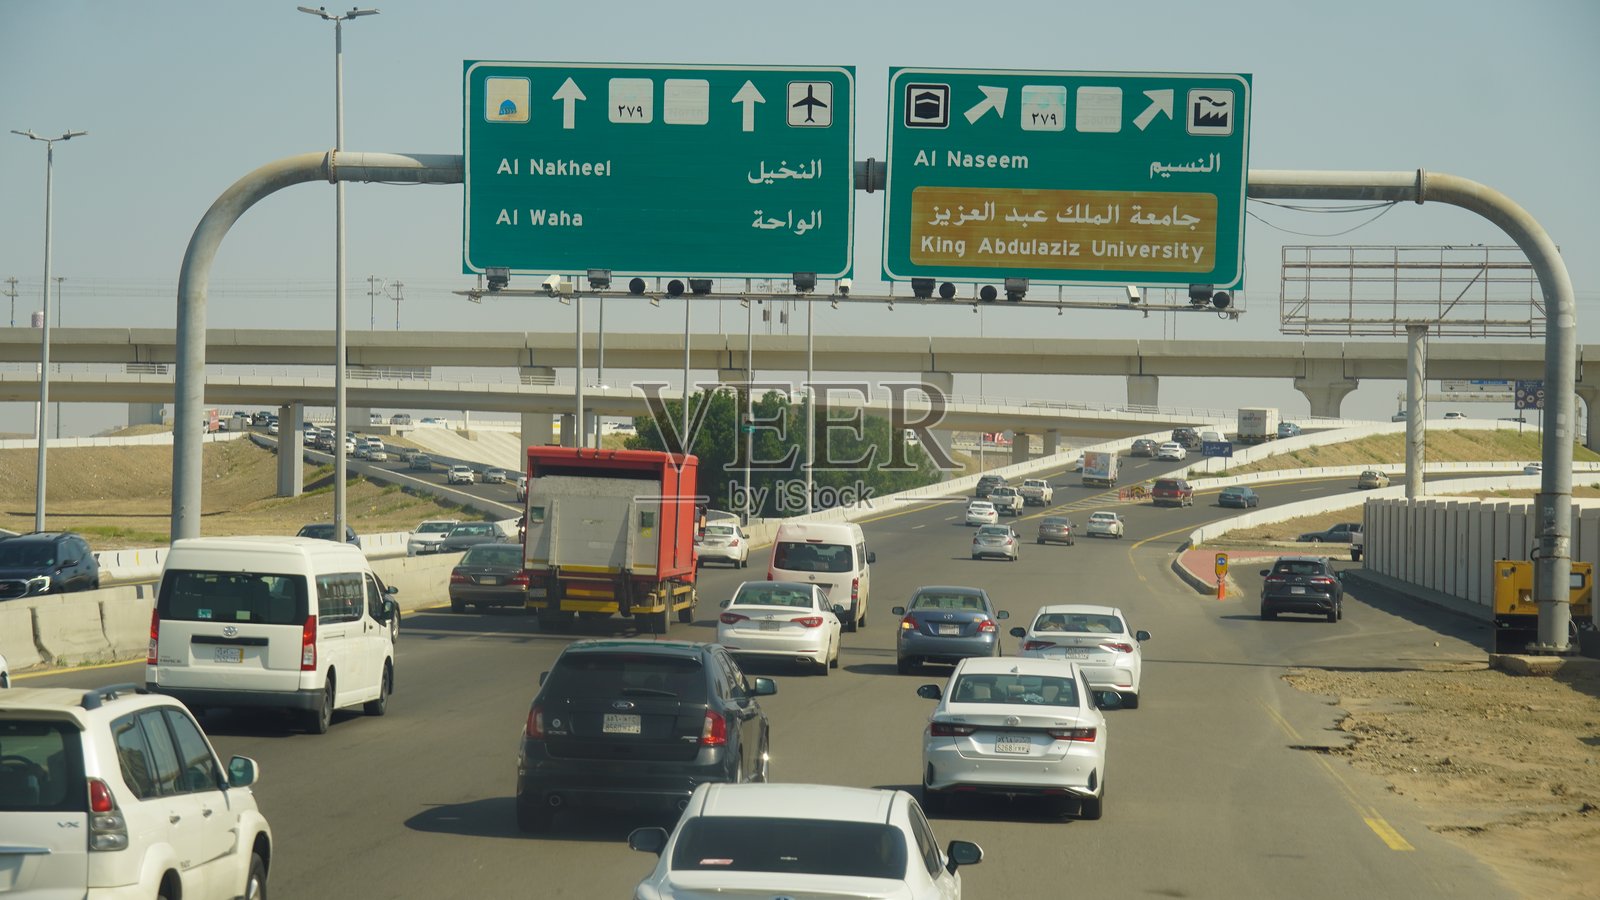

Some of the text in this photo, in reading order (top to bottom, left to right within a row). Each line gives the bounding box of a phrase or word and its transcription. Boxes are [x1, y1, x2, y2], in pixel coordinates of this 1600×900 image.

[618, 105, 643, 118] ٢٧٩
[1031, 112, 1057, 126] ٢٧٩
[496, 158, 611, 177] Al Nakheel
[914, 150, 1029, 169] Al Naseem
[1150, 152, 1221, 179] النسيم
[747, 159, 823, 185] النخيل
[496, 209, 583, 227] Al Waha
[751, 209, 823, 235] الواحة
[928, 201, 1201, 231] جامعة الملك عبد العزيز
[920, 236, 1205, 264] King Abdulaziz University
